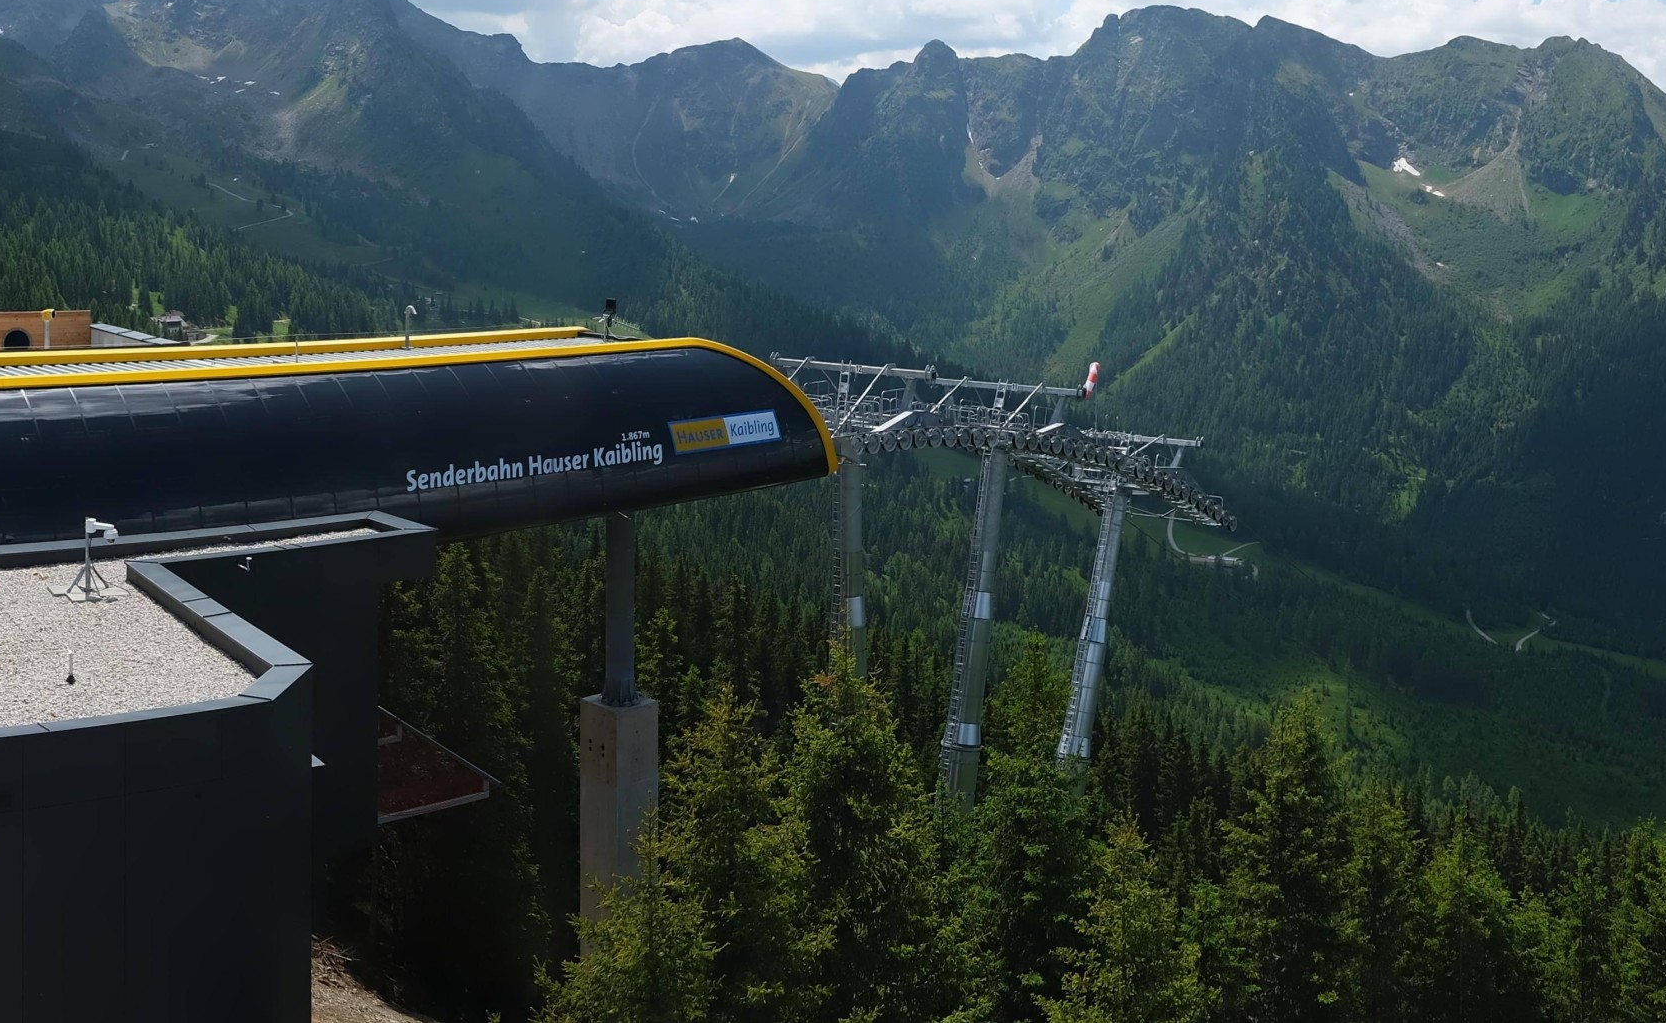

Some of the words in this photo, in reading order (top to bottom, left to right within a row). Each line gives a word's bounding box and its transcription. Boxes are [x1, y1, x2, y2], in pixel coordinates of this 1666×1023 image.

[621, 430, 650, 441] 1.867m
[676, 427, 724, 444] HAUSER
[729, 418, 775, 438] Kaibling
[406, 456, 523, 492] Senderbahn
[528, 452, 589, 476] Hauser
[593, 440, 663, 467] Kaibling
